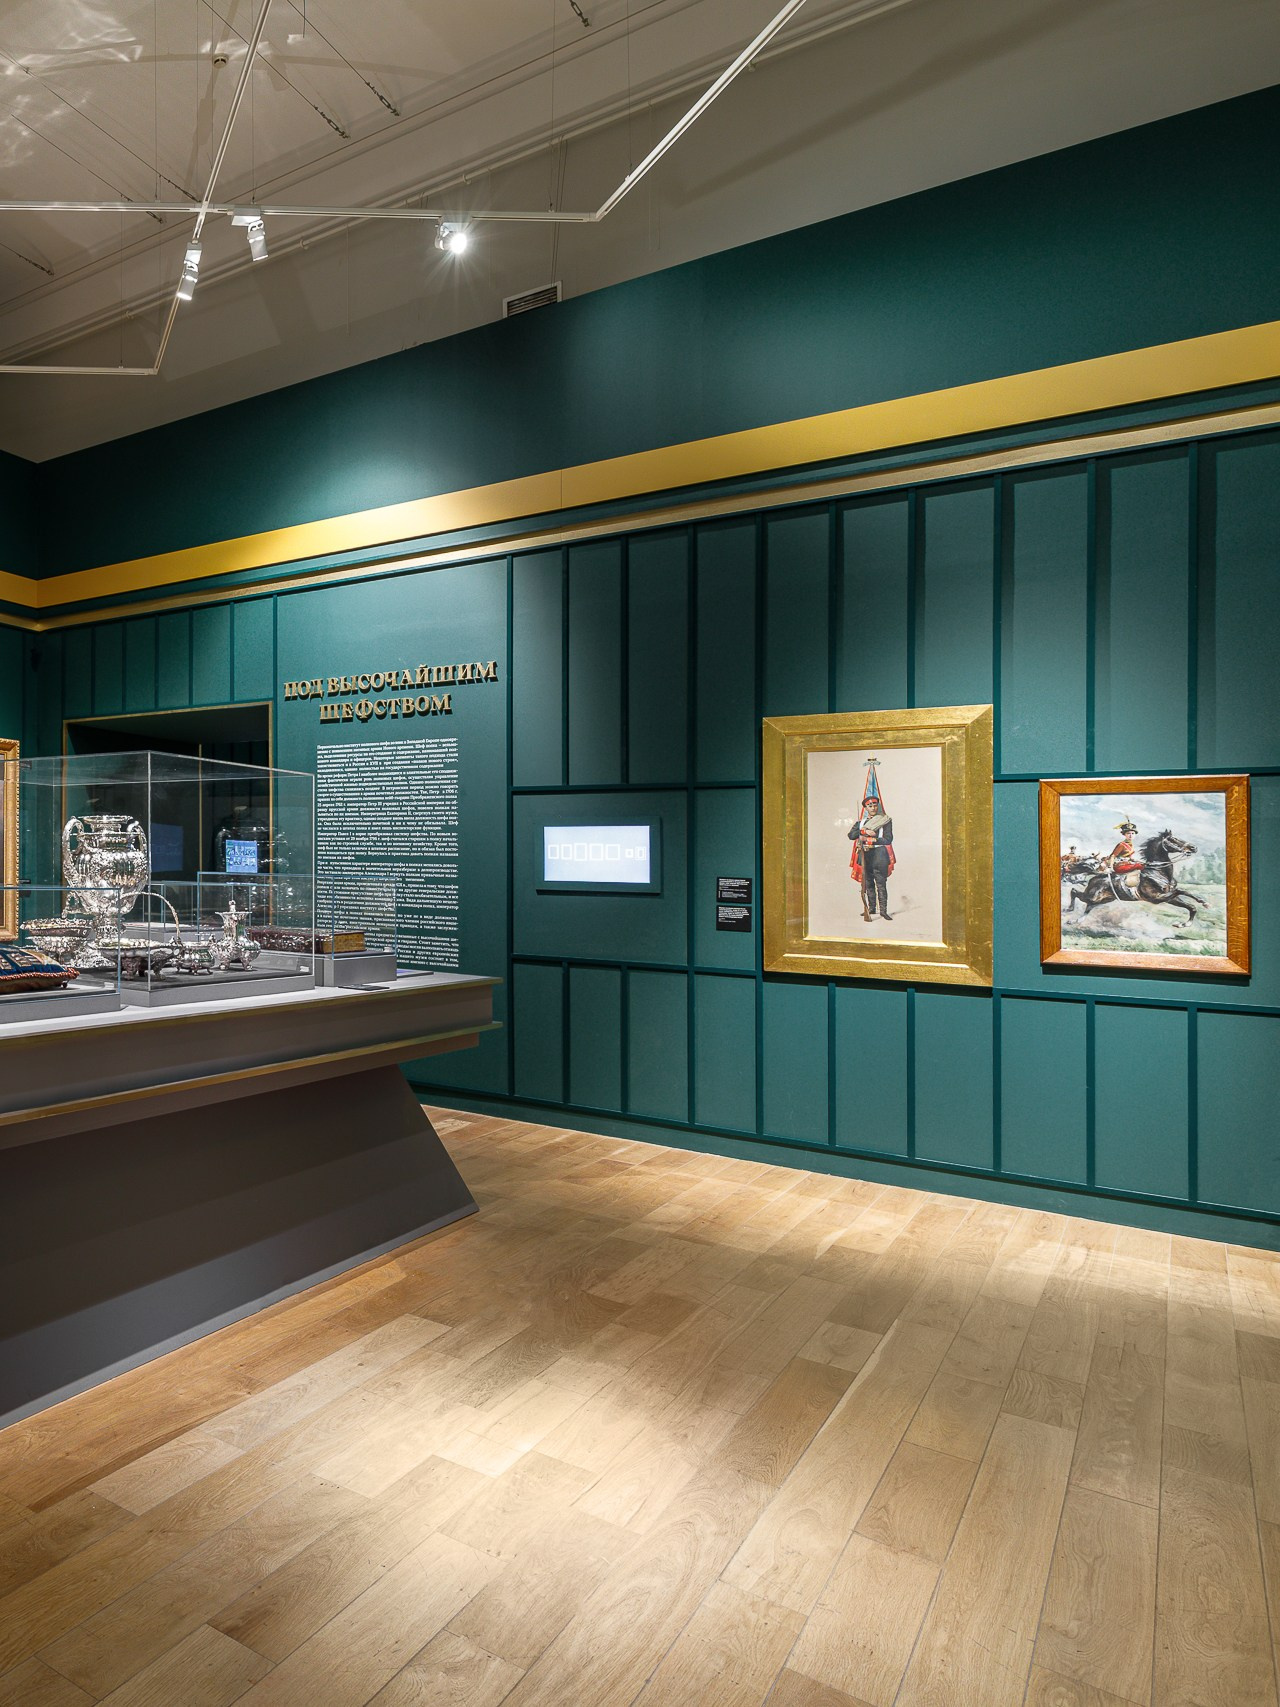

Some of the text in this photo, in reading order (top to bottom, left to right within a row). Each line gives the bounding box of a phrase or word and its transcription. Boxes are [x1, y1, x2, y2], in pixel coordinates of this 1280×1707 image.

[284, 661, 499, 701] ПОД ВЫСОЧАЙШИМ
[320, 694, 452, 722] ШЕФСТВОМ
